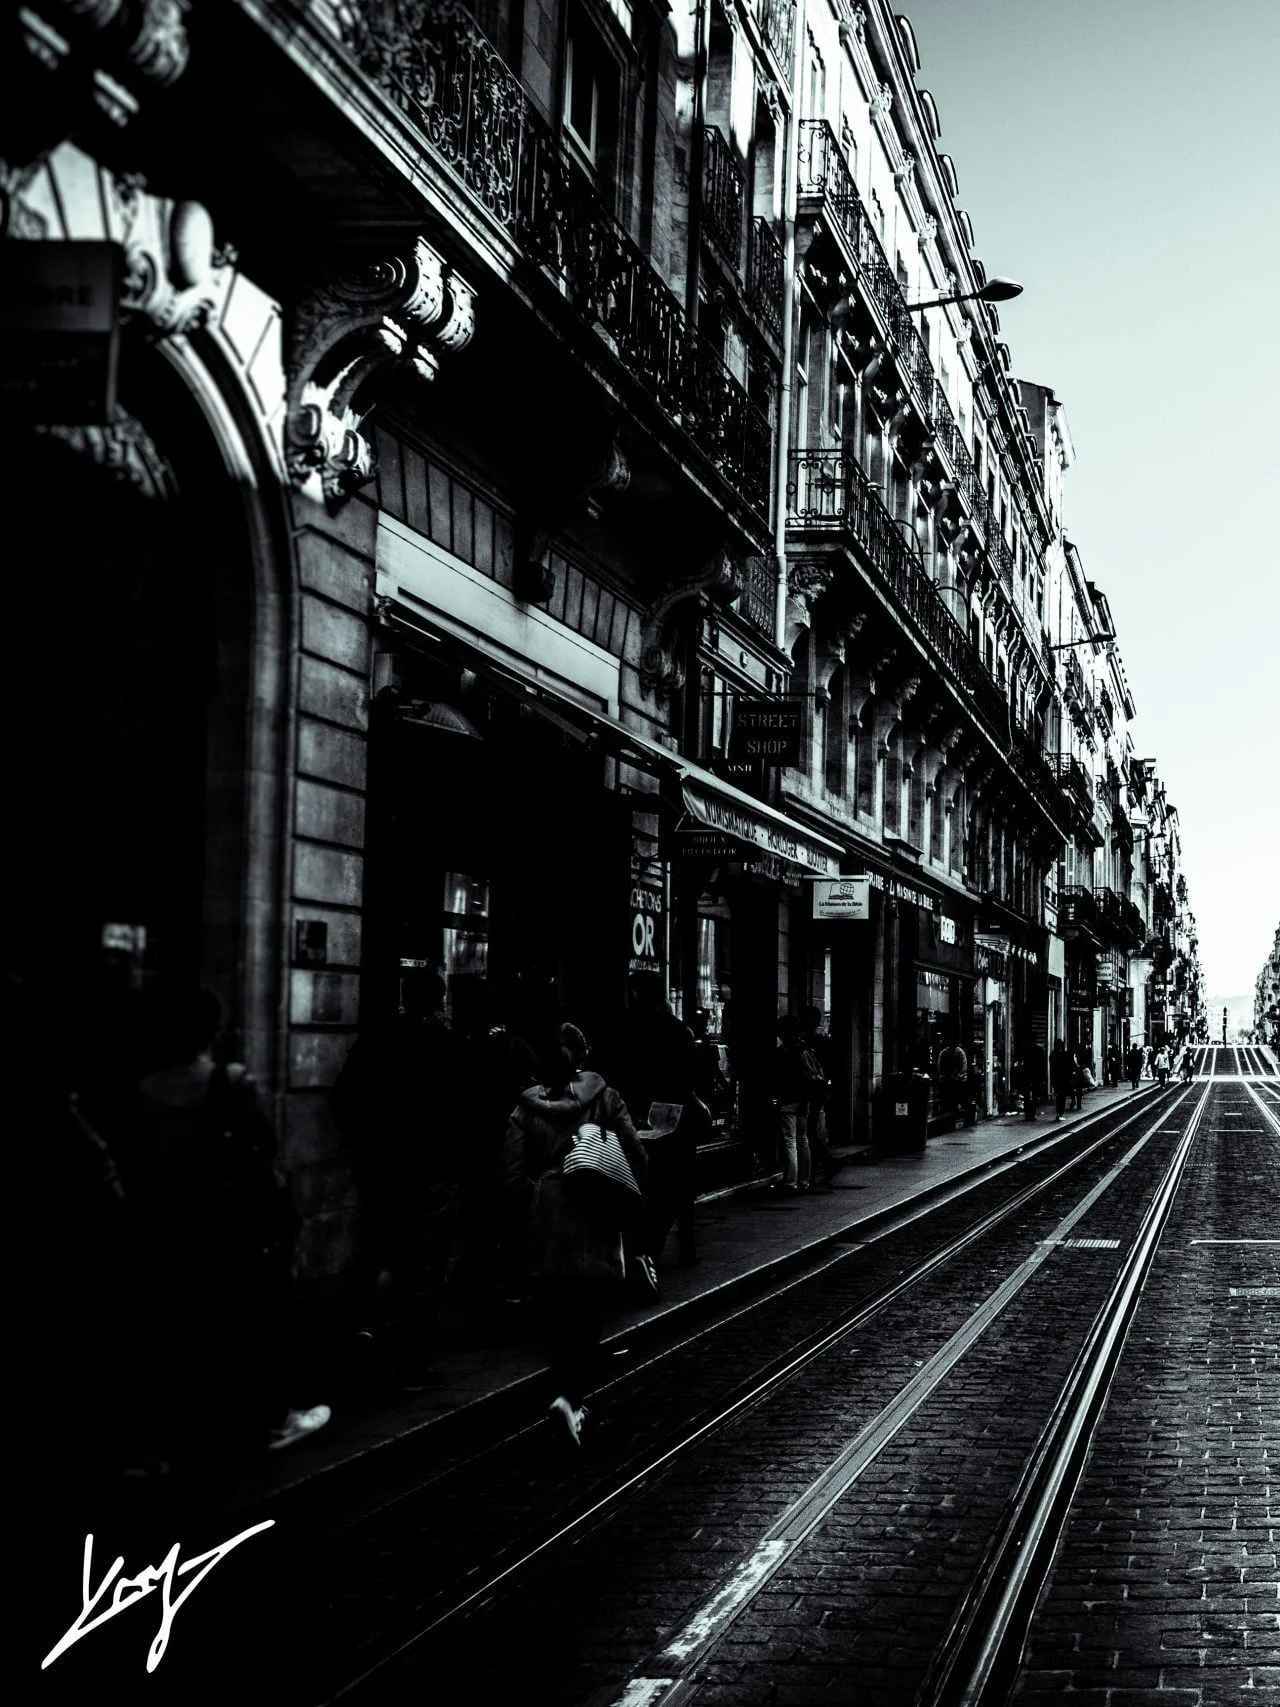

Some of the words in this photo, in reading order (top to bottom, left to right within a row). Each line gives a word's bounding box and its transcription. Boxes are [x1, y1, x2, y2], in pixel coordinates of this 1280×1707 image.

[737, 714, 798, 728] STREET
[747, 740, 787, 754] SHOP
[704, 798, 758, 842] NUMISMATIQUE
[767, 826, 799, 860] HORLOGER
[632, 913, 655, 957] OR
